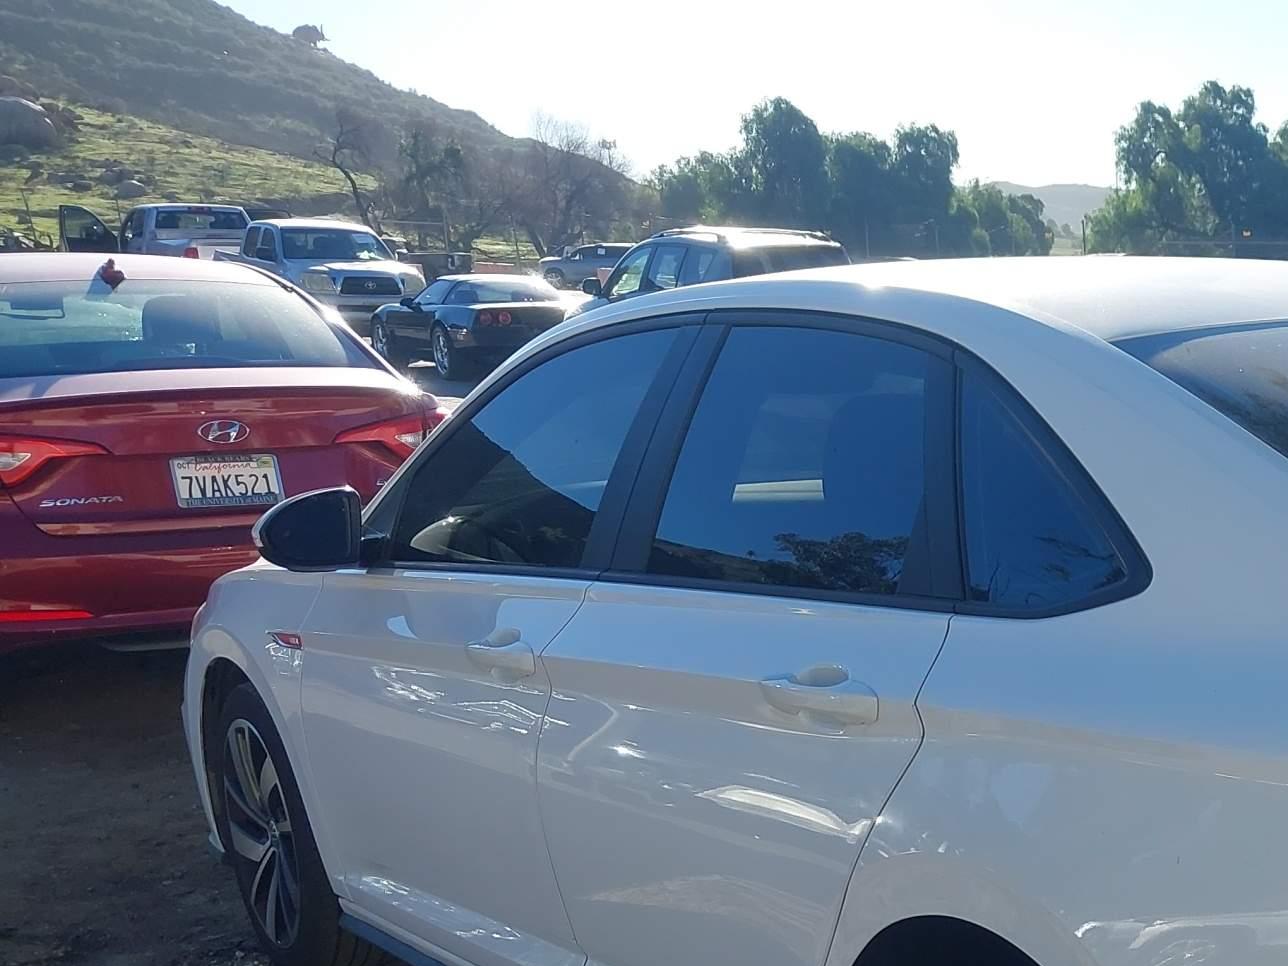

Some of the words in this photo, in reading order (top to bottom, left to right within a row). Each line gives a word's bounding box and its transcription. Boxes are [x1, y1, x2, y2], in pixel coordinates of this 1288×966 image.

[177, 462, 190, 470] OCT
[194, 462, 252, 474] California
[181, 473, 275, 499] 7VAK521
[40, 496, 124, 507] SONATA
